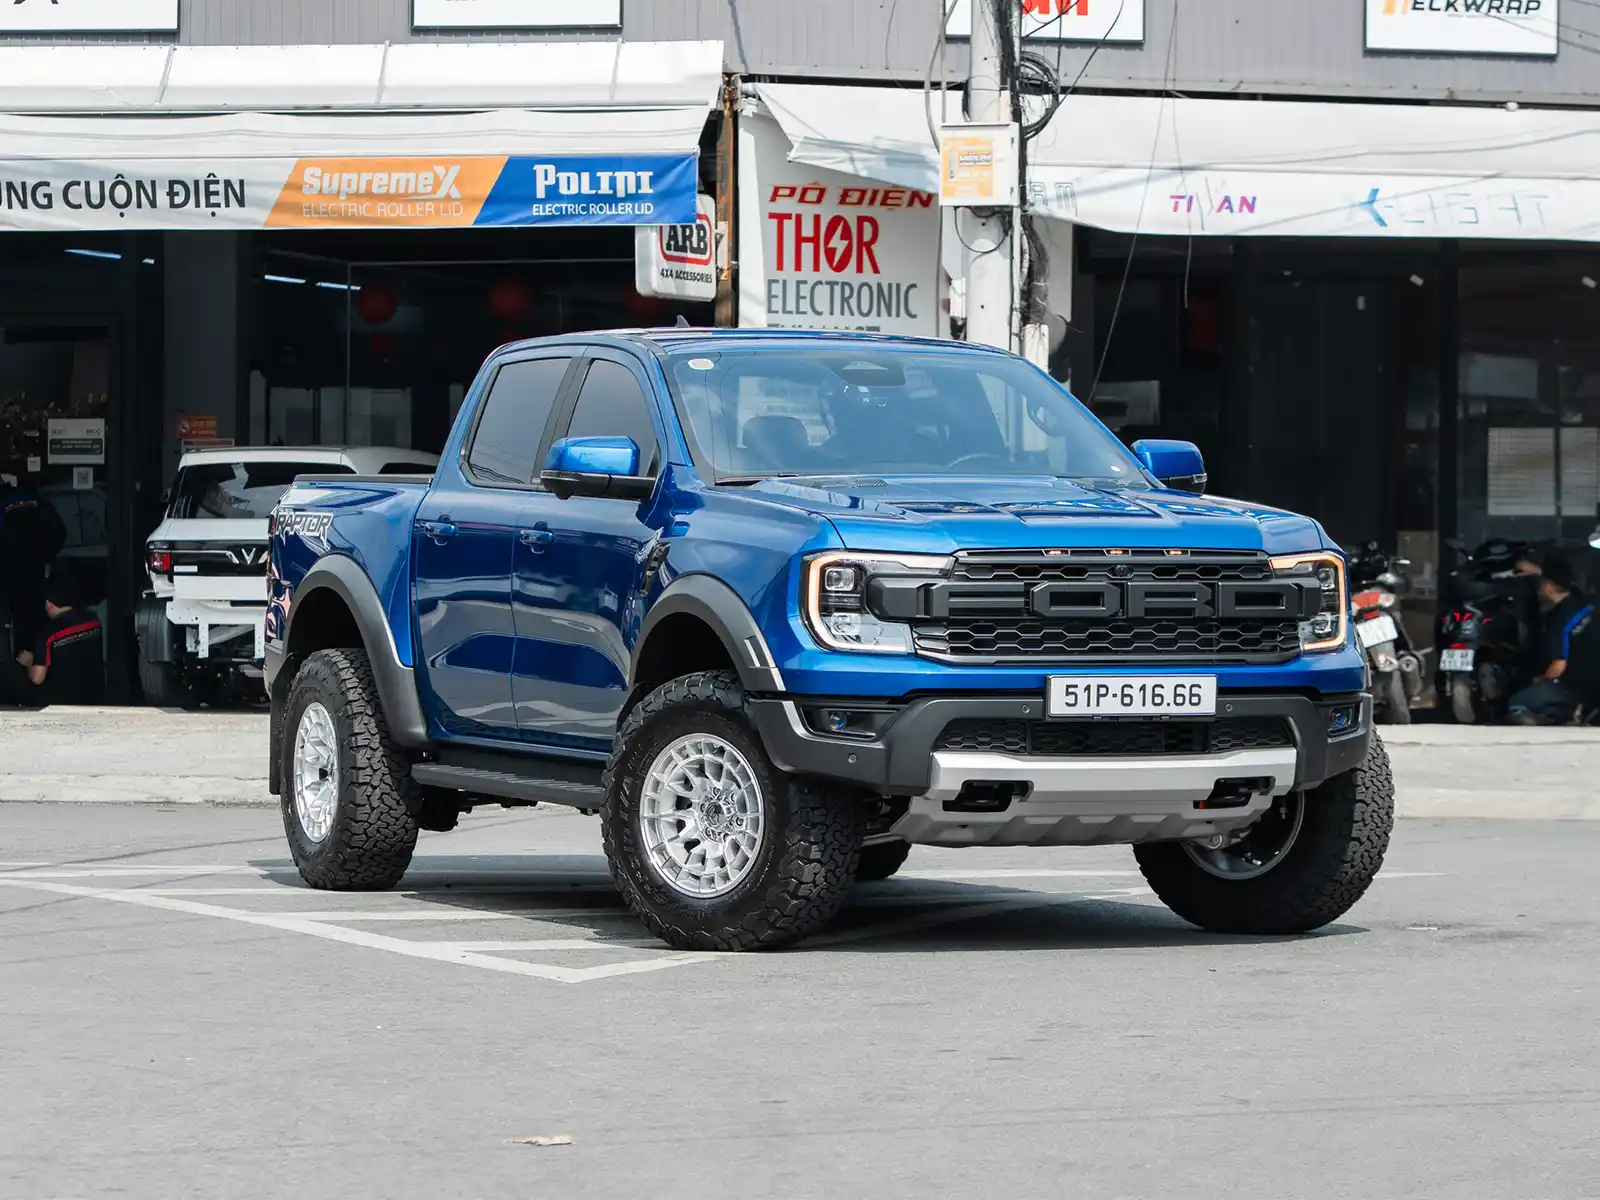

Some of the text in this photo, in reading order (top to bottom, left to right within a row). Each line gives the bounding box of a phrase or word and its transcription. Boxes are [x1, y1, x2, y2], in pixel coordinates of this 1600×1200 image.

[62, 174, 158, 217] CUỘN
[166, 173, 246, 217] ĐIỆN
[302, 165, 463, 200] SupremeX
[769, 180, 827, 204] PÔ
[302, 202, 464, 218] ELECTRIC ROLLER LID
[532, 202, 654, 216] ELECTRIC ROLLER LID
[666, 223, 708, 256] ARB
[767, 213, 881, 275] THOR
[675, 269, 713, 283] ACCESSORIES
[767, 279, 918, 319] ELECTRONIC
[276, 511, 334, 547] RAPTOR
[929, 580, 1301, 620] FORD
[1064, 683, 1202, 708] 51P-616.66
